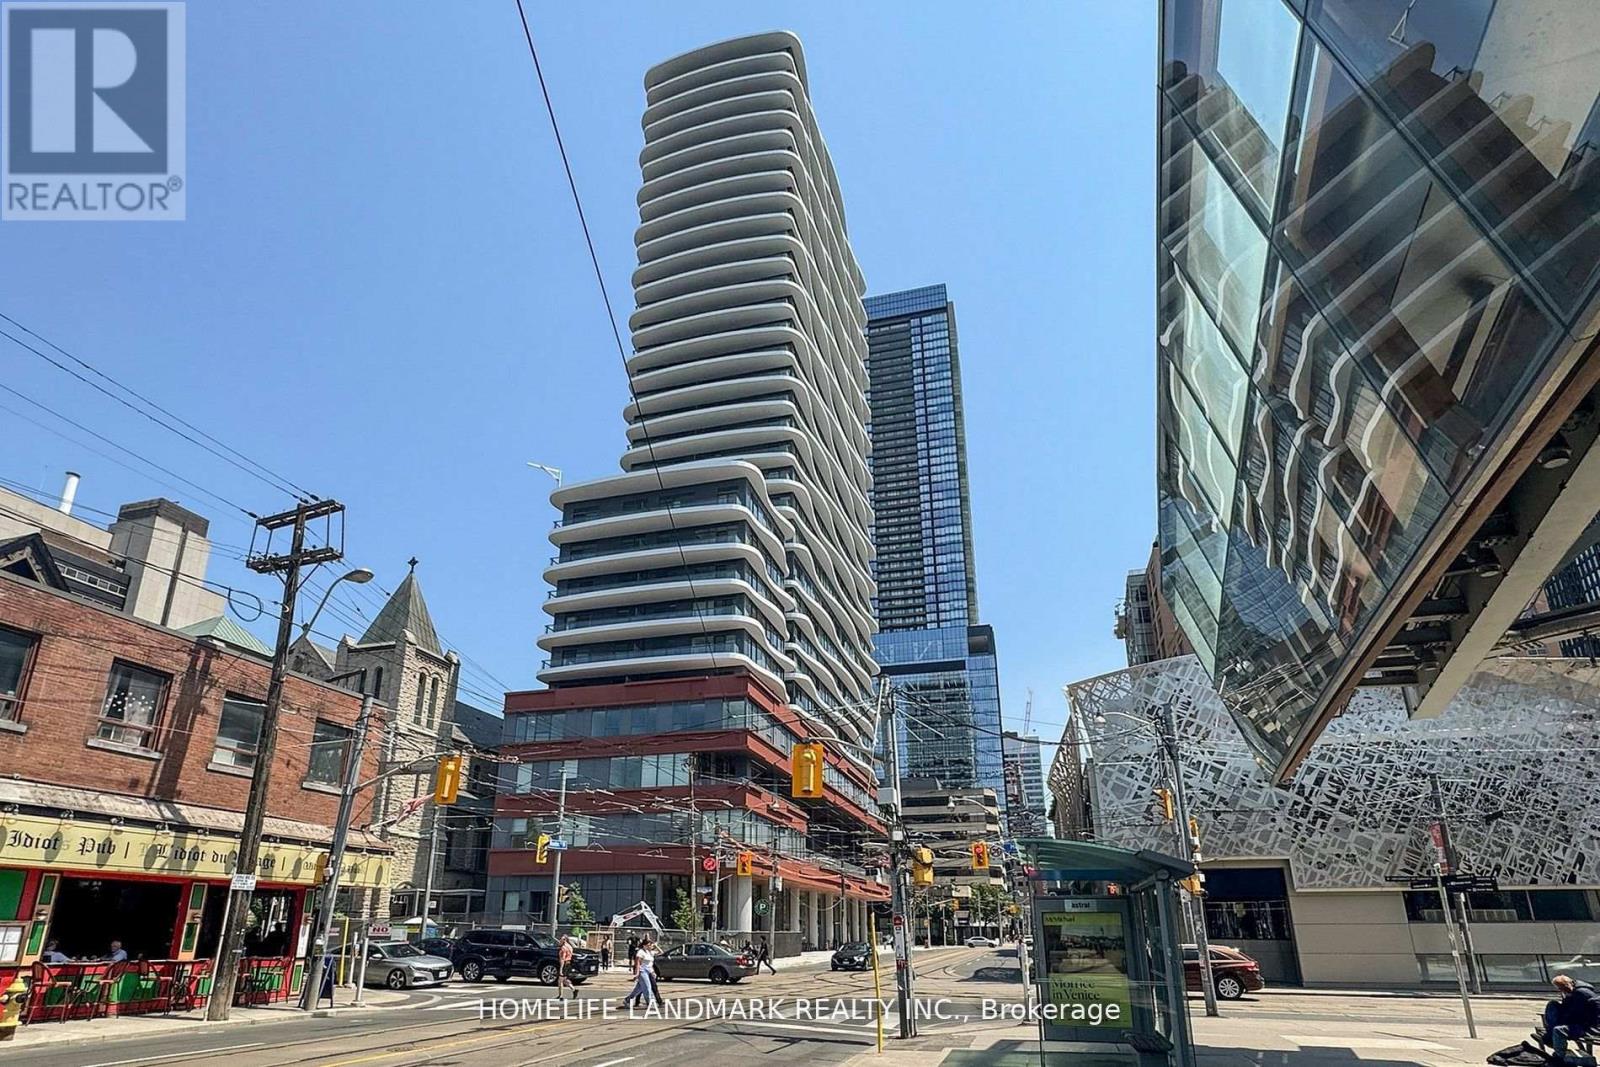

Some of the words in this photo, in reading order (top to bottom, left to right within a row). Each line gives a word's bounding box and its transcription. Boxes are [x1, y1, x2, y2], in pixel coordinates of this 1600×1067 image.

[6, 830, 60, 850] Idiot
[76, 836, 116, 855] Pub
[156, 843, 206, 862] L'idiot
[211, 850, 227, 863] du
[1063, 989, 1100, 1000] Venice
